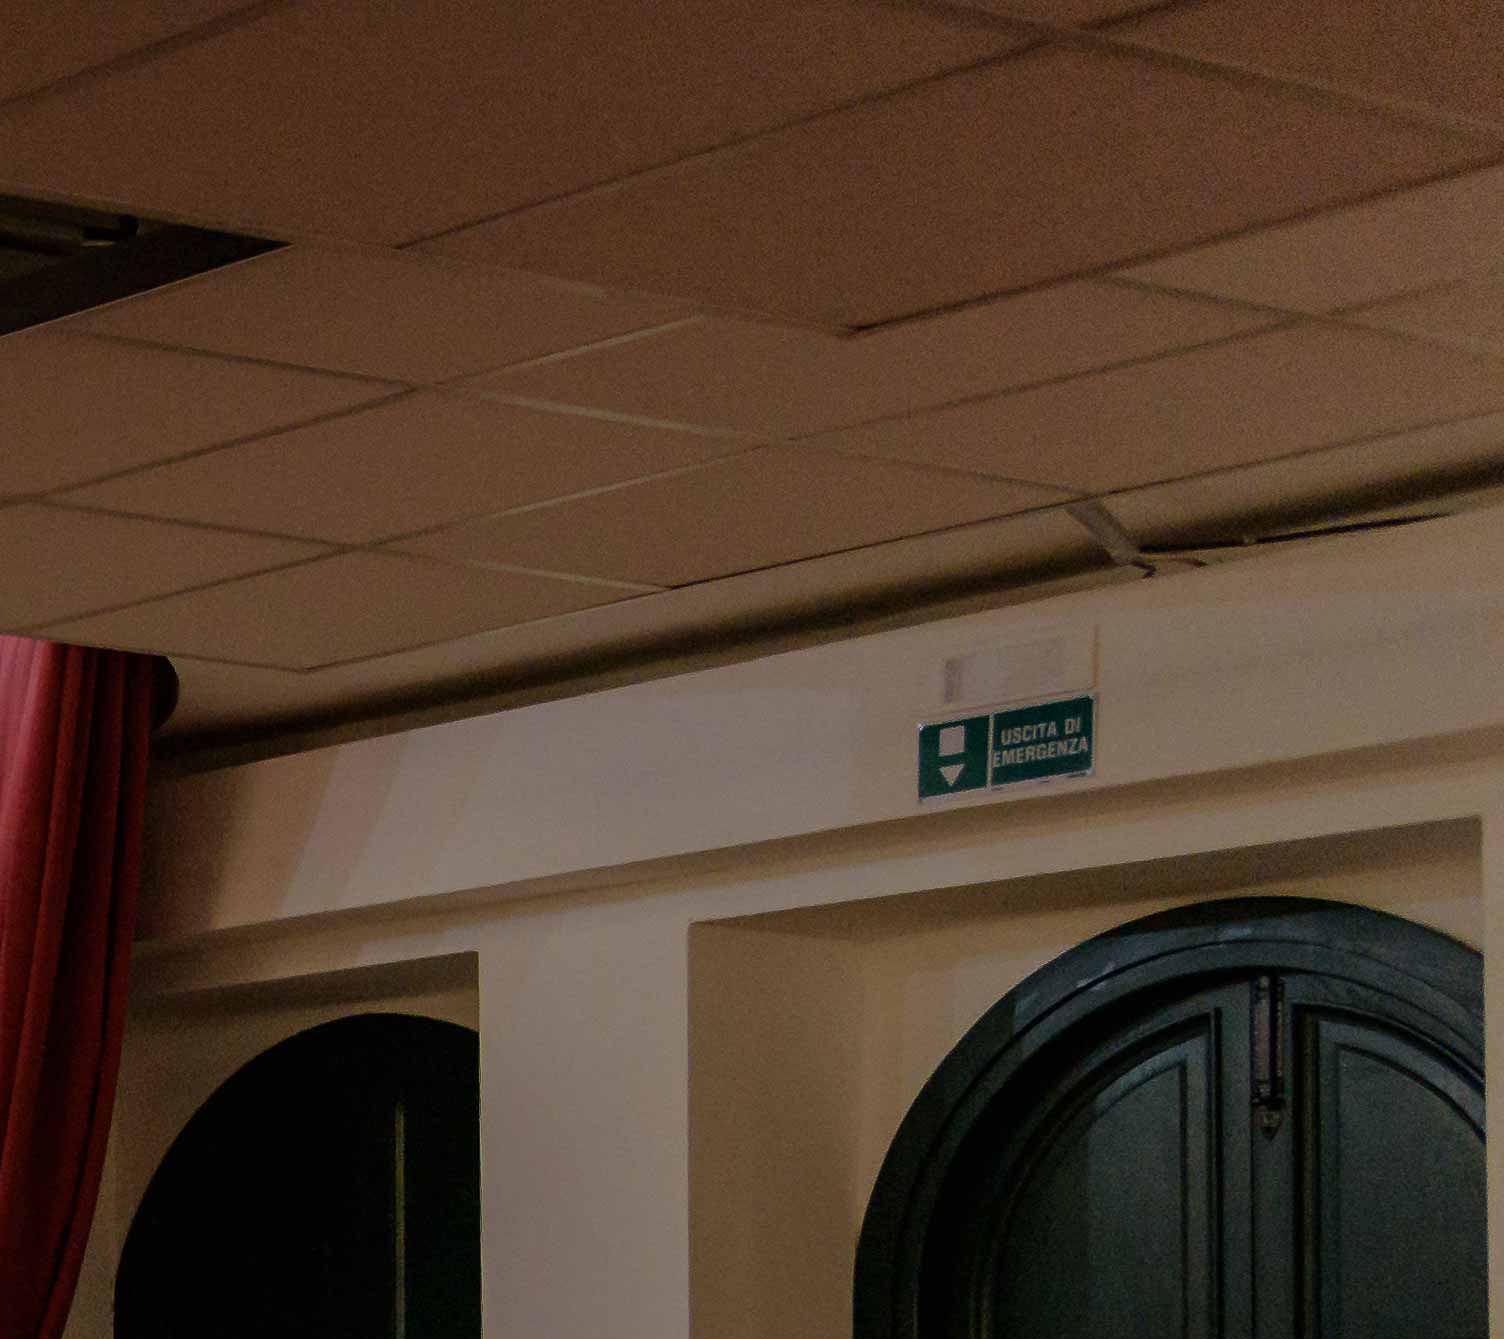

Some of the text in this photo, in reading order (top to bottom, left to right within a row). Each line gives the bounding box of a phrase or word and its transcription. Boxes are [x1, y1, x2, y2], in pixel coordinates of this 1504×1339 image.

[1000, 716, 1081, 746] USCITA DI
[992, 736, 1088, 767] EMERGENZA
